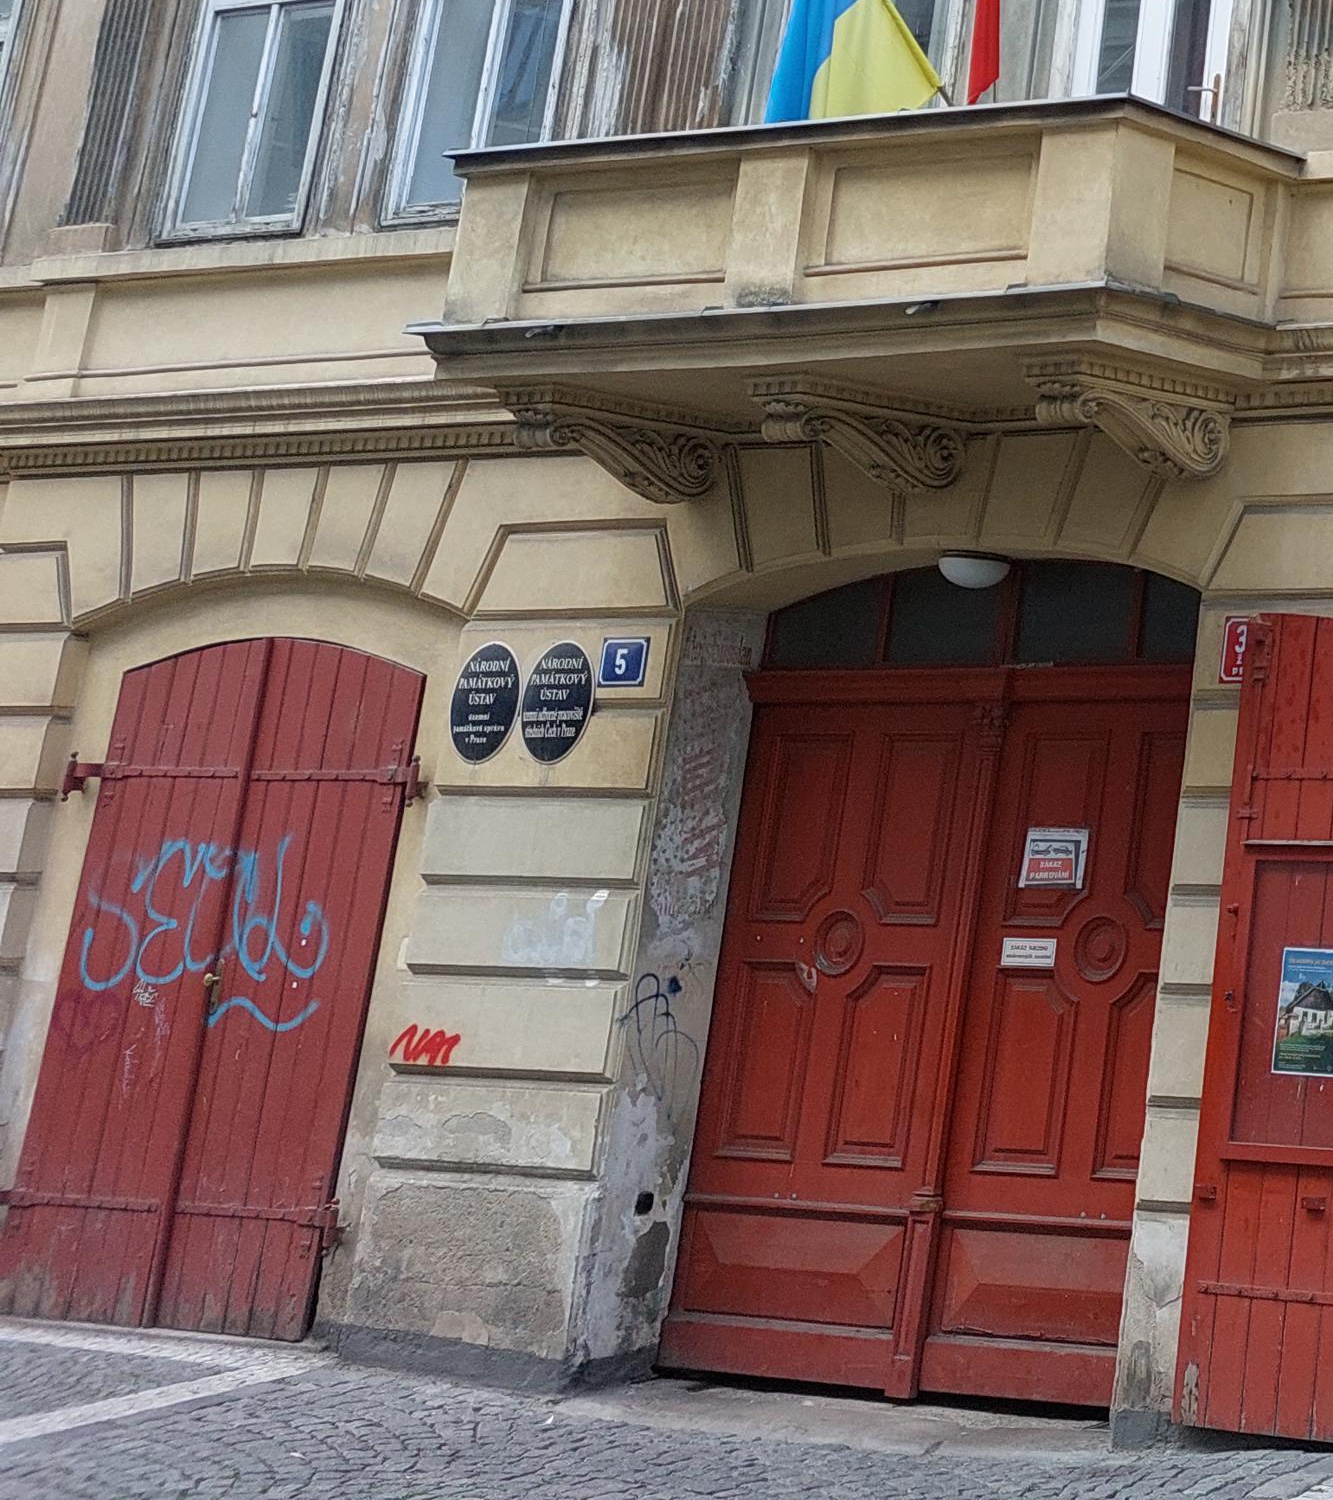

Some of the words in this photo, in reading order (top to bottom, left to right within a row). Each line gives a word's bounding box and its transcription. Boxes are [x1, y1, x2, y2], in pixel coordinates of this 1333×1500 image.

[468, 657, 511, 672] NÁRODNÍ
[539, 656, 585, 670] NÁRODNÍ
[614, 648, 629, 675] 5
[458, 673, 516, 689] PAMÁTKOVÝ
[530, 670, 589, 686] PAMÁTKOVÝ
[468, 691, 497, 705] ÚSTAV
[539, 687, 570, 701] ÚSTAV
[1039, 859, 1063, 869] ZÁKAZ
[1029, 869, 1070, 880] PARKOVÁNÍ
